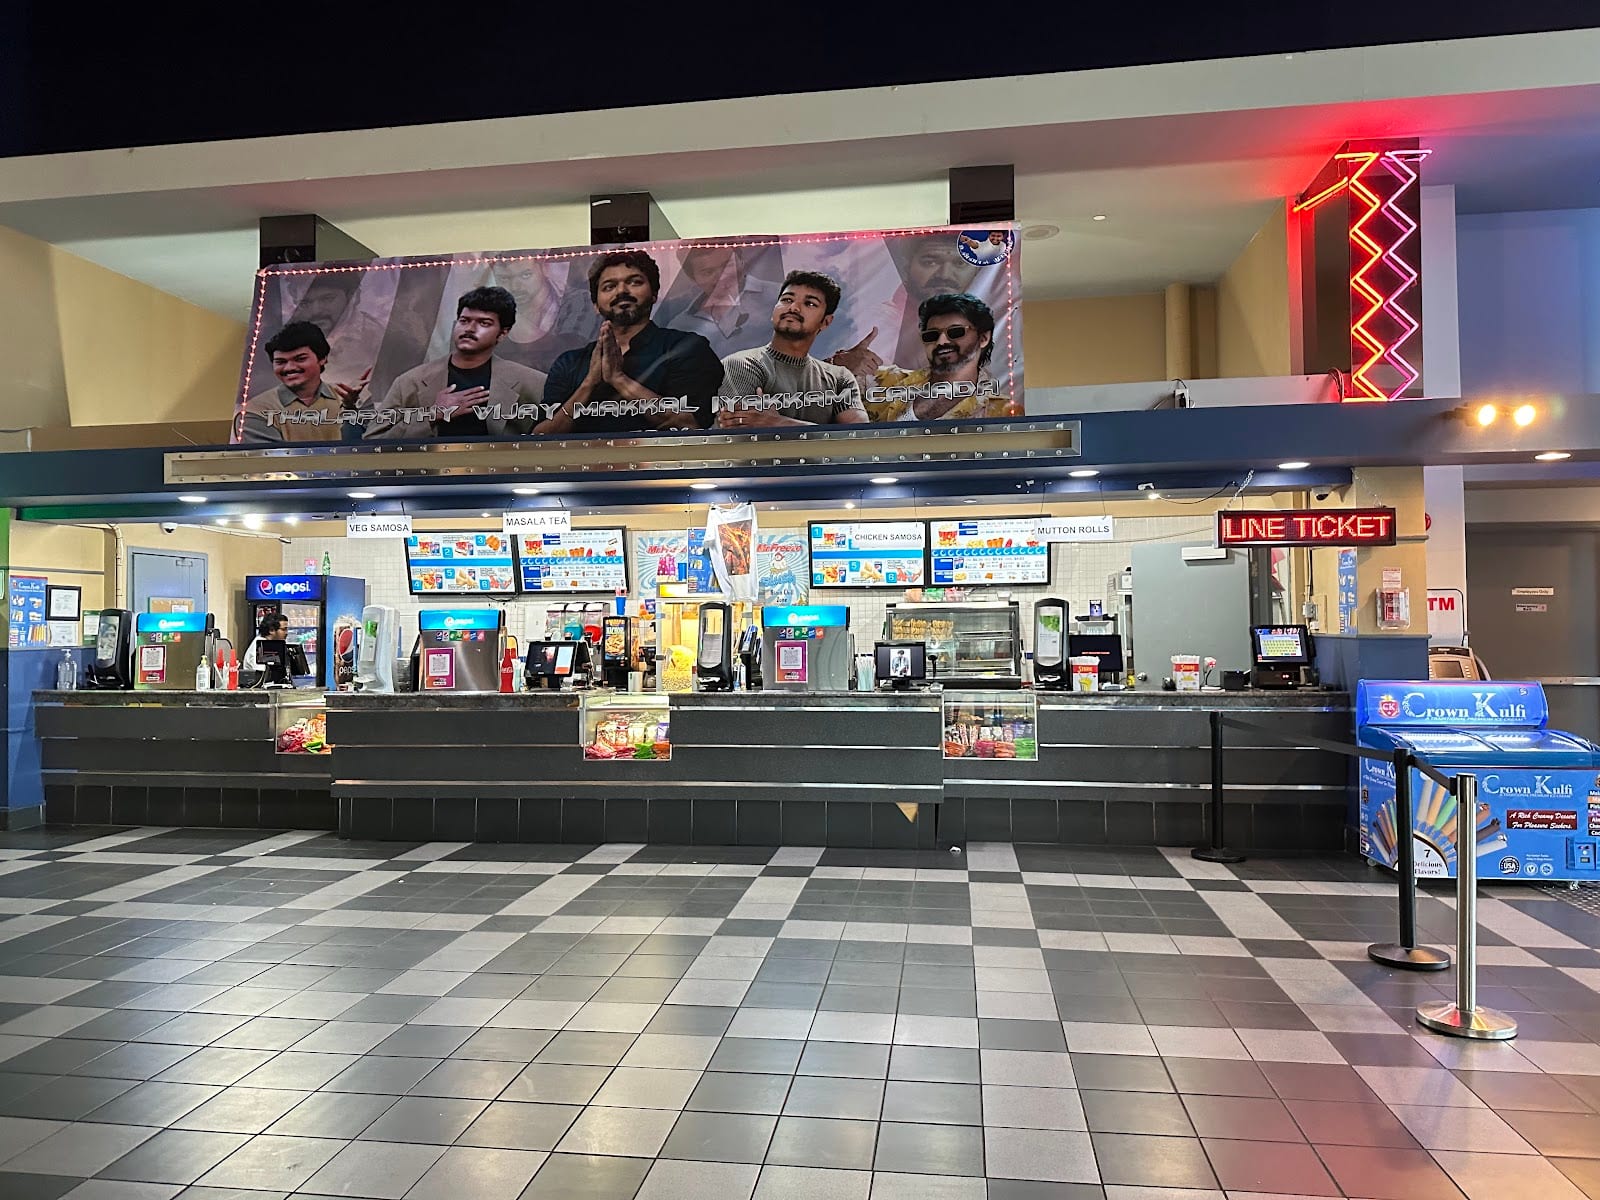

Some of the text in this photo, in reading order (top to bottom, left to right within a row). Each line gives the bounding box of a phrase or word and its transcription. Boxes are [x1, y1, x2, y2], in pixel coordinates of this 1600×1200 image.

[261, 379, 999, 427] THALAPATHY VIJAY MAKKAL IYAKKAM CANADA
[506, 516, 568, 526] MASALA TEA
[349, 524, 409, 532] VEG SAMOSA
[1037, 527, 1076, 535] MUTTON
[1078, 525, 1110, 533] ROLLS
[1293, 515, 1391, 538] TICKET
[855, 533, 922, 541] CHICKEN SAMOSA
[1427, 597, 1455, 611] TM
[1402, 692, 1527, 718] Crown Kulfi
[1482, 774, 1573, 795] Crown Kulfi
[1509, 811, 1517, 819] A
[1518, 811, 1531, 819] Rich
[1532, 811, 1554, 820] Creamy
[1512, 821, 1523, 829] For
[1524, 821, 1549, 829] Pleasure
[1424, 849, 1431, 858] 7
